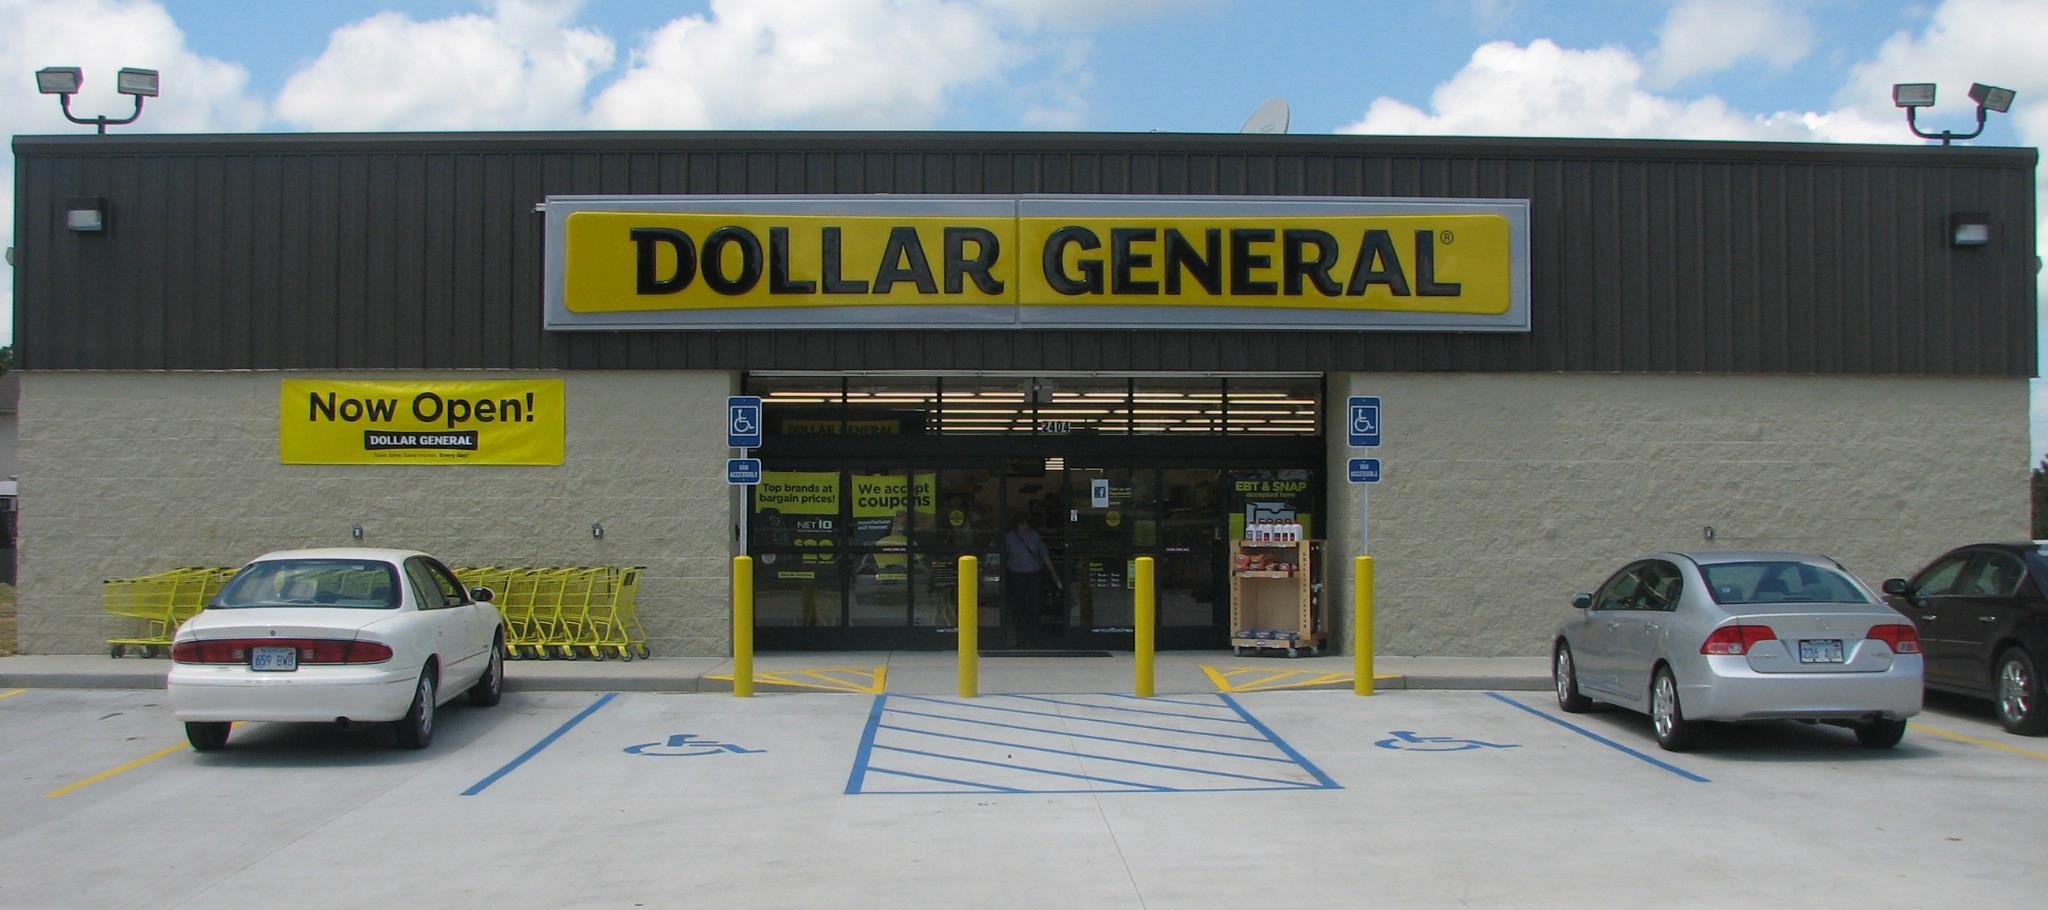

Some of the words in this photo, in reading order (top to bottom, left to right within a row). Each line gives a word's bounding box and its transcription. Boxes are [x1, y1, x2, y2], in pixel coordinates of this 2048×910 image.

[630, 226, 1005, 296] DOLLAR
[309, 391, 398, 422] Now
[412, 391, 535, 428] Open!
[1042, 420, 1072, 432] 2404
[369, 435, 417, 445] DOLLAR
[419, 435, 472, 446] GENERAL
[763, 483, 782, 494] Top
[784, 483, 820, 493] brands
[822, 484, 833, 493] at
[858, 484, 881, 495] We
[1235, 480, 1260, 492] EBT
[1261, 480, 1271, 492] &
[1272, 480, 1307, 492] SNAP
[759, 493, 799, 505] bargain
[801, 493, 836, 505] prices!
[255, 655, 272, 666] 659
